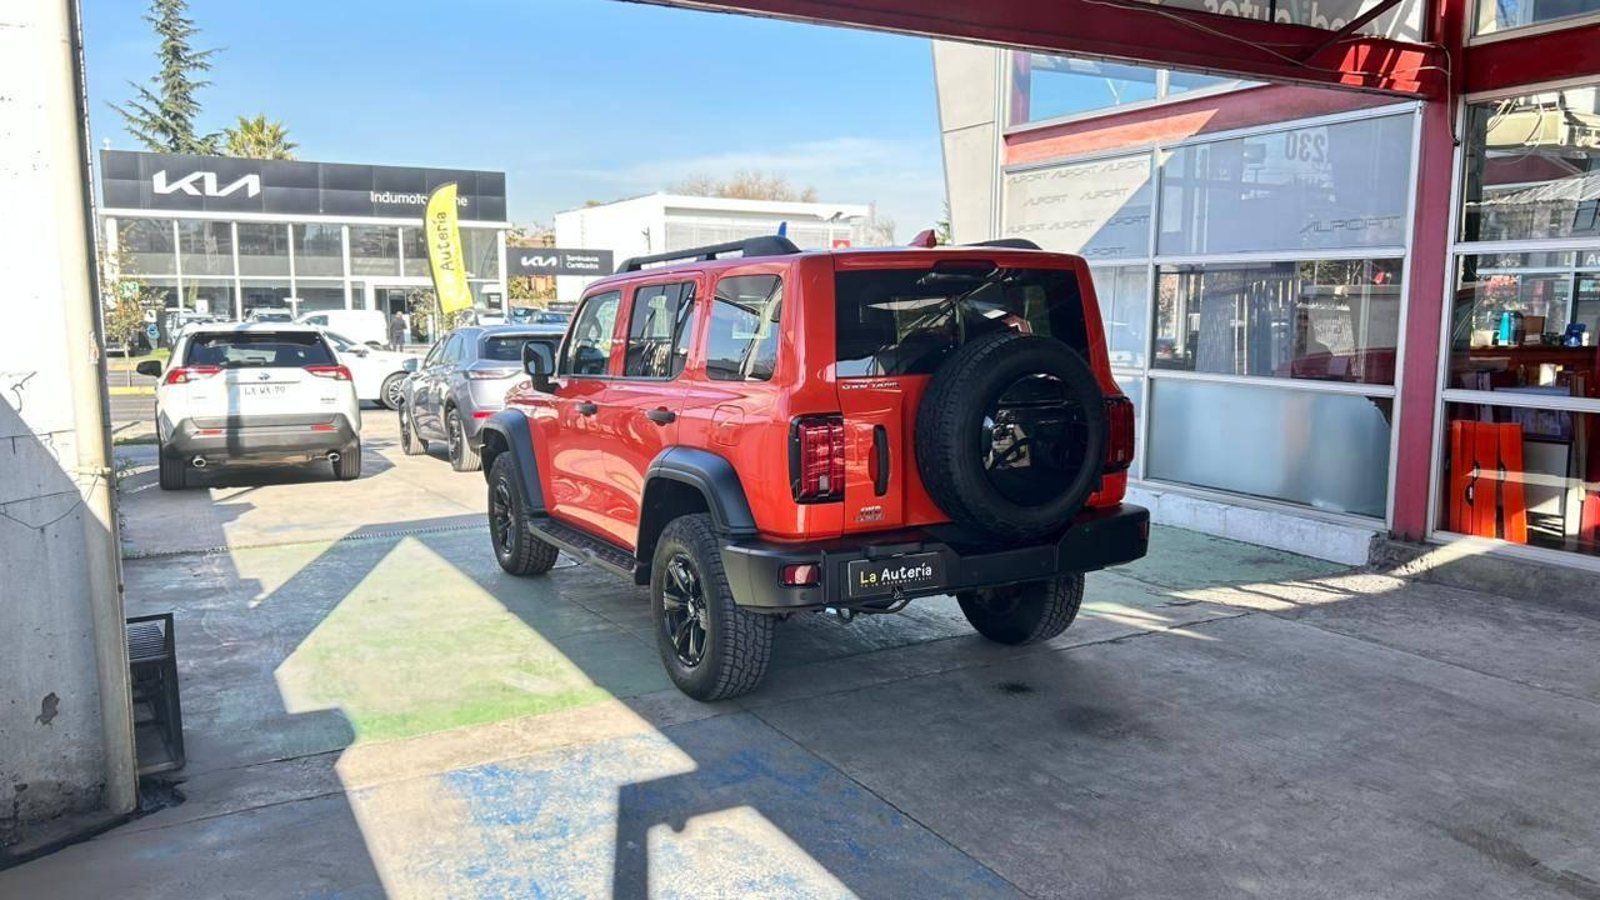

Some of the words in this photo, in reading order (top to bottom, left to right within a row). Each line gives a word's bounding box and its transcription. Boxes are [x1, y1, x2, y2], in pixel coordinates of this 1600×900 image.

[152, 169, 260, 197] KIA
[370, 190, 428, 206] Indumoto
[432, 211, 455, 271] Autería
[520, 256, 558, 267] KIA
[860, 570, 876, 584] La
[880, 562, 932, 582] Autería
